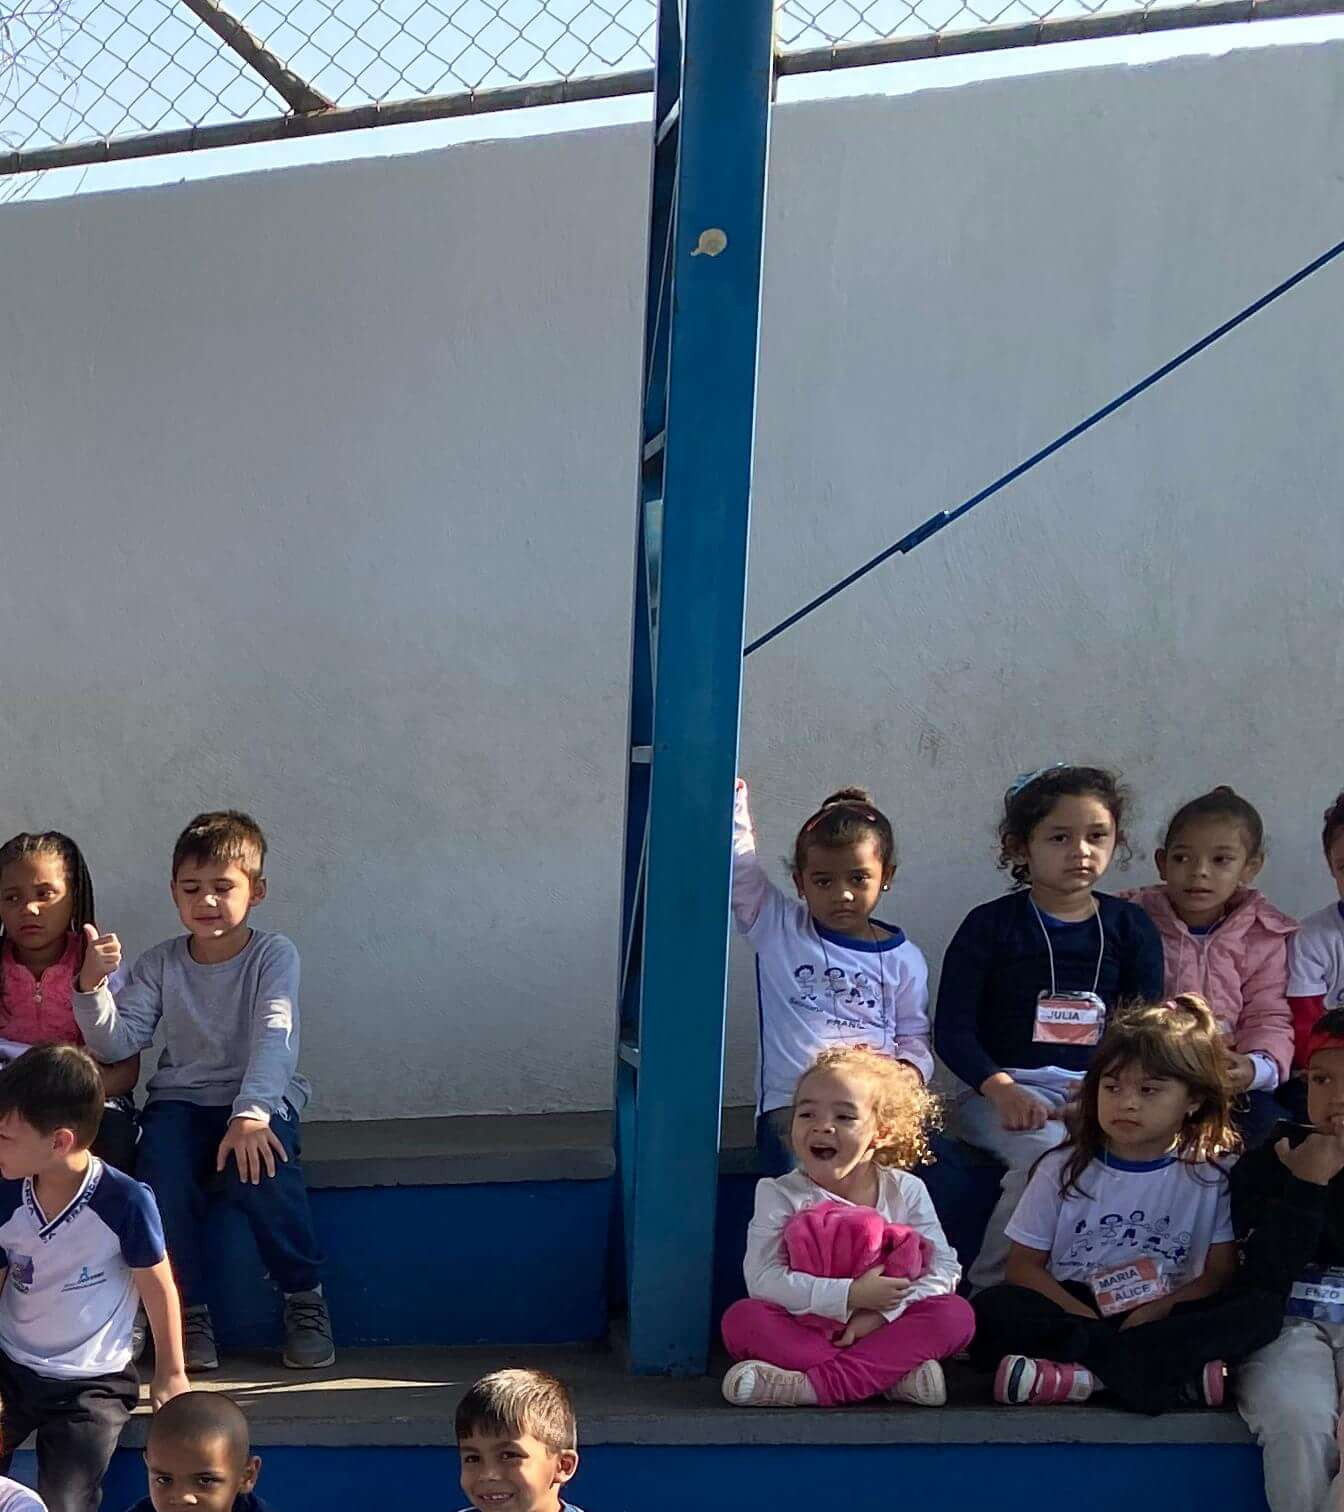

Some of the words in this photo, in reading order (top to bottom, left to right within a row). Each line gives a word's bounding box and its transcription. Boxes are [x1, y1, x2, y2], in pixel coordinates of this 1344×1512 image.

[1047, 1009, 1081, 1021] JULIA
[1098, 1268, 1140, 1290] MARIA
[1114, 1283, 1152, 1302] ALICE
